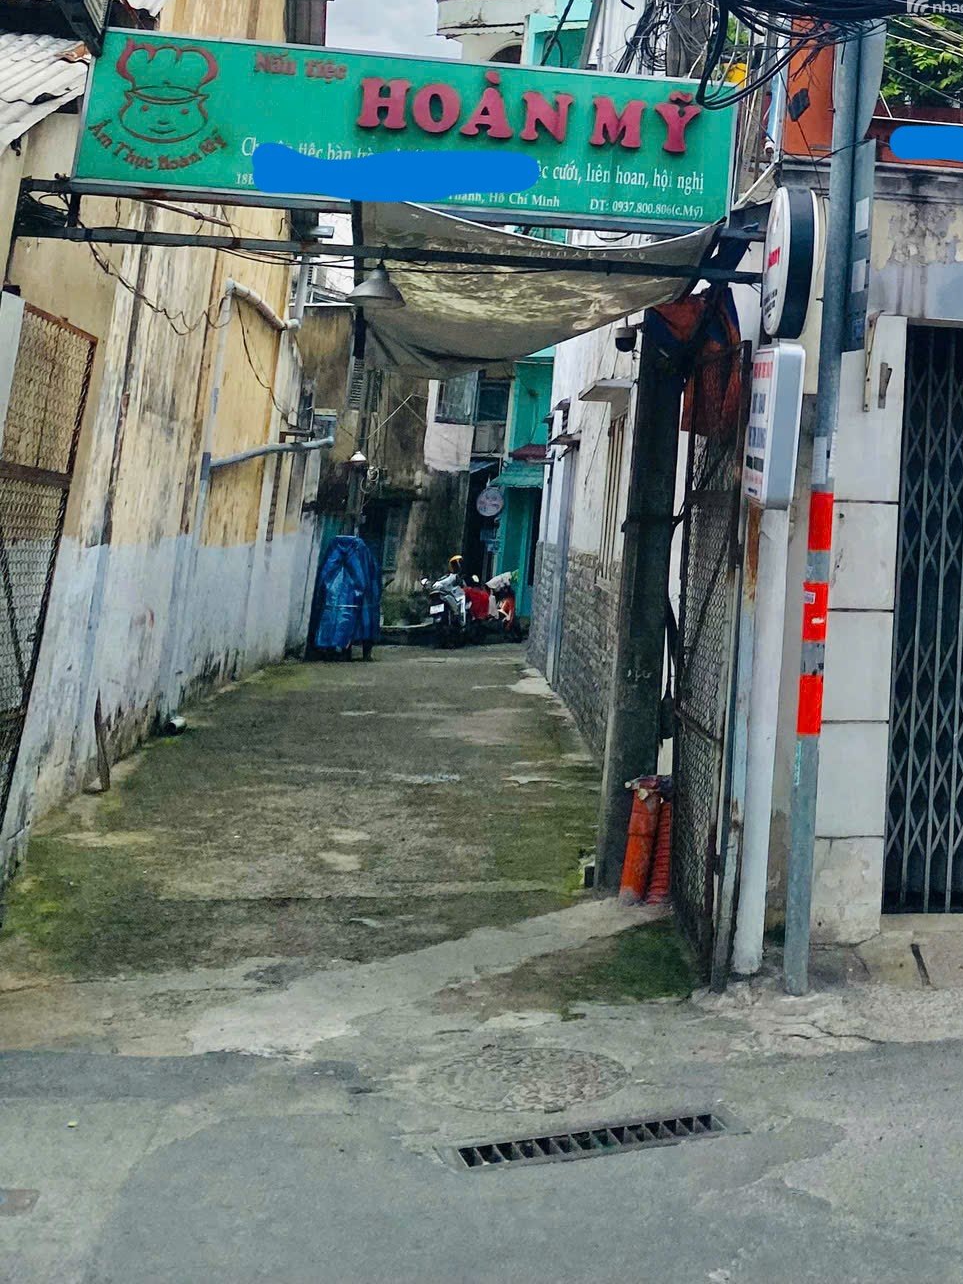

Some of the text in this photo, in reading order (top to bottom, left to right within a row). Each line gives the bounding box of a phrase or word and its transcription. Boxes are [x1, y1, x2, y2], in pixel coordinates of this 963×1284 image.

[357, 70, 703, 153] HOÀN MỸ
[615, 165, 649, 188] hoan,
[653, 168, 673, 192] hội
[677, 171, 704, 196] nghị
[509, 192, 528, 205] Chí
[532, 194, 560, 207] Minh
